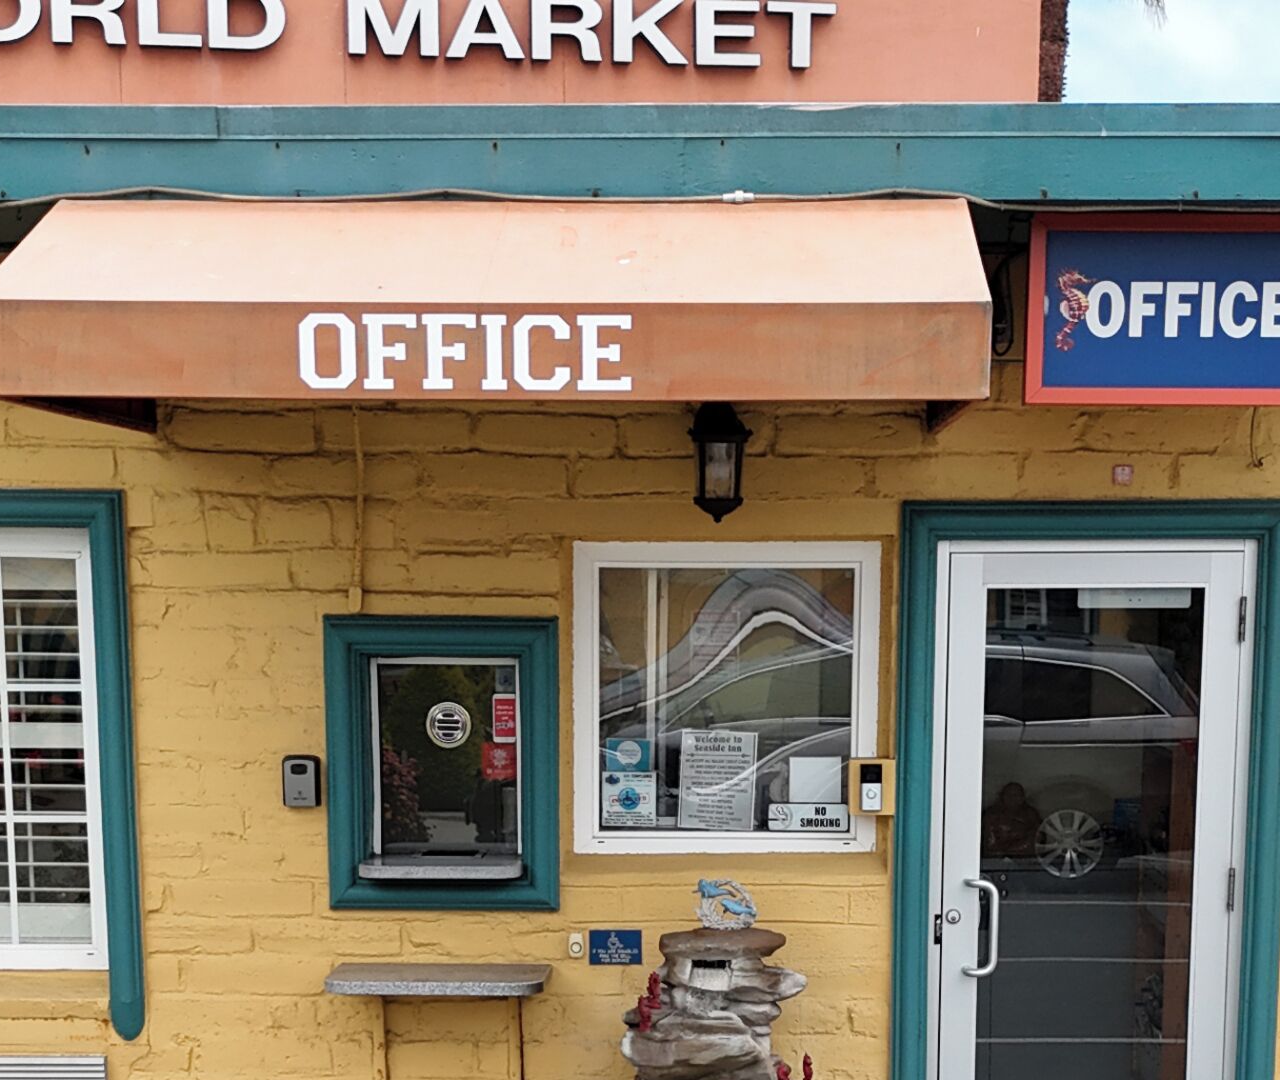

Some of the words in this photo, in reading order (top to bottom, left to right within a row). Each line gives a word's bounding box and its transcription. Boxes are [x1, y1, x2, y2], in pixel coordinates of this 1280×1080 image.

[347, 0, 838, 69] MARKET
[298, 312, 632, 393] OFFICE
[694, 735, 731, 743] Welcome
[734, 735, 743, 743] to
[694, 744, 726, 752] Seaside
[814, 806, 827, 816] NO
[800, 818, 841, 828] SMOKING
